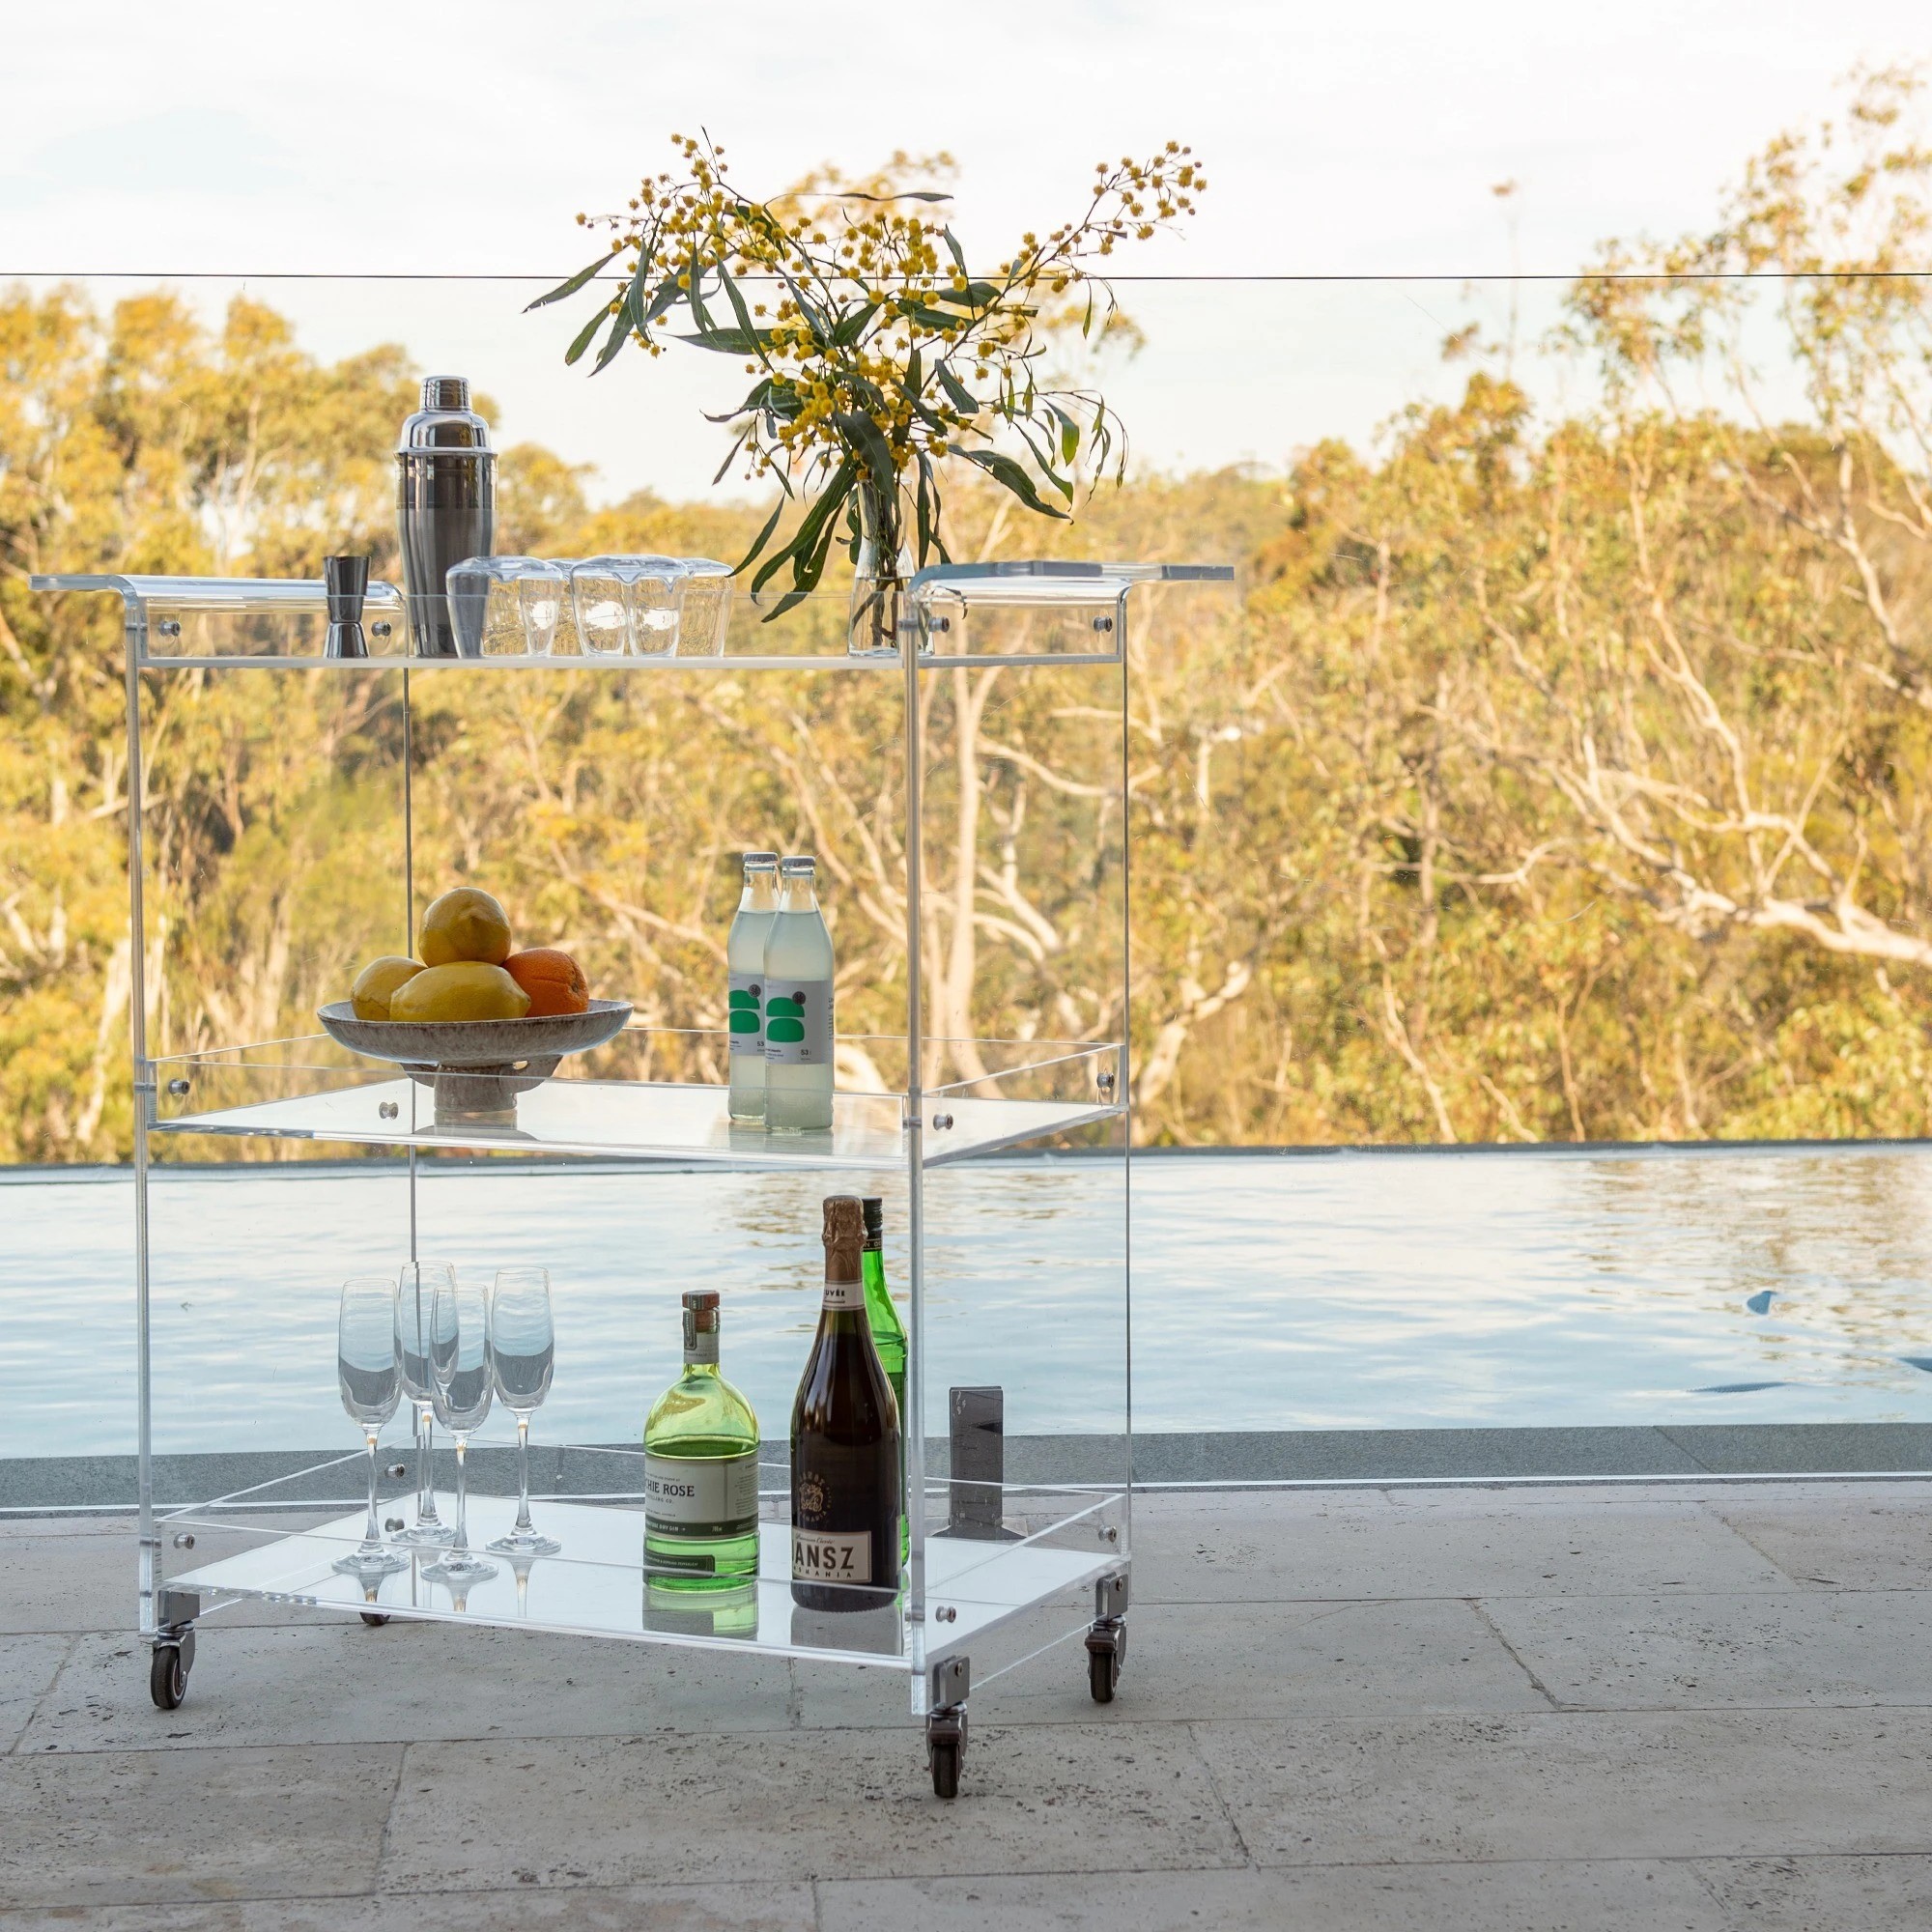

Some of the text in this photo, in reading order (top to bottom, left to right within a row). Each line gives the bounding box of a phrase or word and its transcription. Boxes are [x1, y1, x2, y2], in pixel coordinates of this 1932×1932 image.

[824, 1288, 845, 1296] UVÉE
[663, 1484, 695, 1496] ROSE
[795, 1541, 854, 1570] ANSZ
